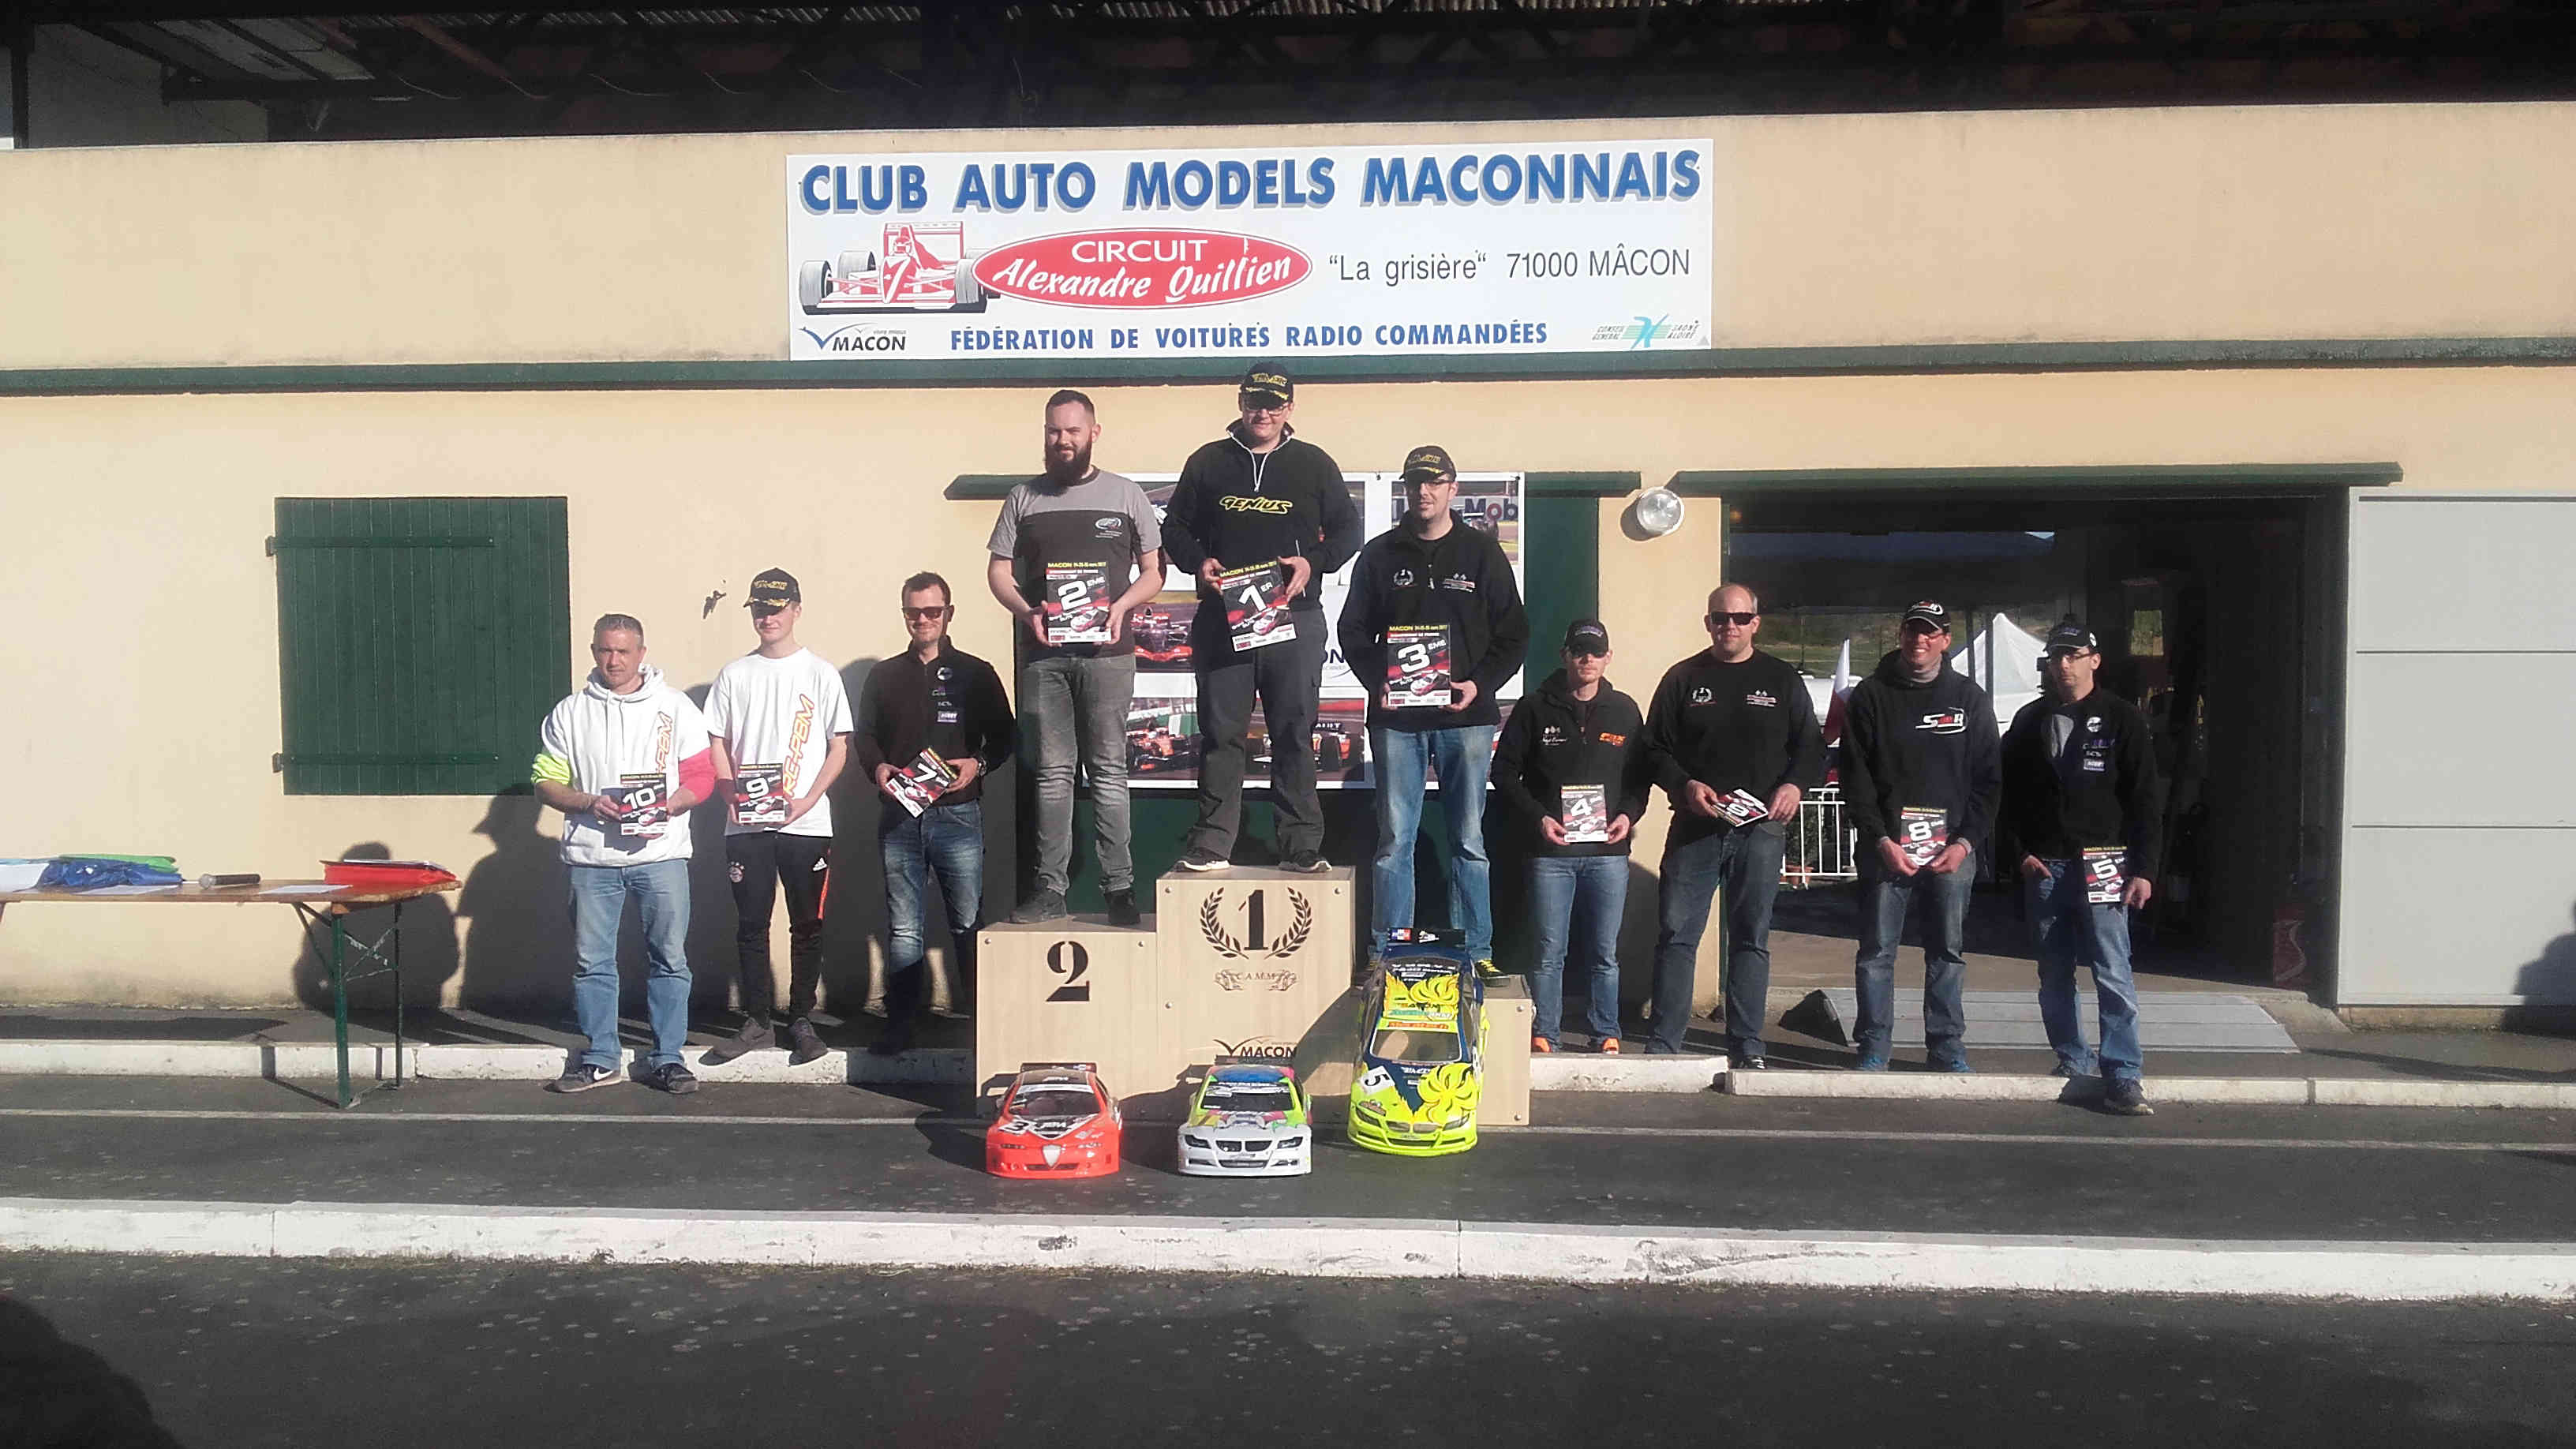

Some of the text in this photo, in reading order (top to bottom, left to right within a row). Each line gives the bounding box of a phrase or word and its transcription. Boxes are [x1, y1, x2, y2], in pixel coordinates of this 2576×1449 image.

[799, 150, 1701, 214] CLUB AUTO MODELS MACONNAIS
[1071, 239, 1208, 263] CIRCUIT
[1507, 253, 1578, 279] 71000
[1589, 243, 1690, 277] MÂCON
[992, 256, 1292, 303] Alexandre Quillien
[832, 335, 906, 351] MACON
[951, 319, 1548, 350] FÉDÉRATION DE VOITURES RADIO COMMANDÉES
[1058, 580, 1091, 611] 2
[1238, 584, 1267, 612] 1
[1398, 643, 1430, 673] 3
[913, 762, 938, 783] 7
[623, 788, 657, 810] 10
[746, 777, 770, 799] 9
[1571, 798, 1593, 817] 4
[1908, 821, 1932, 841] 8
[2091, 858, 2118, 880] 5
[1237, 889, 1269, 951] 1
[1045, 939, 1091, 1002] 2
